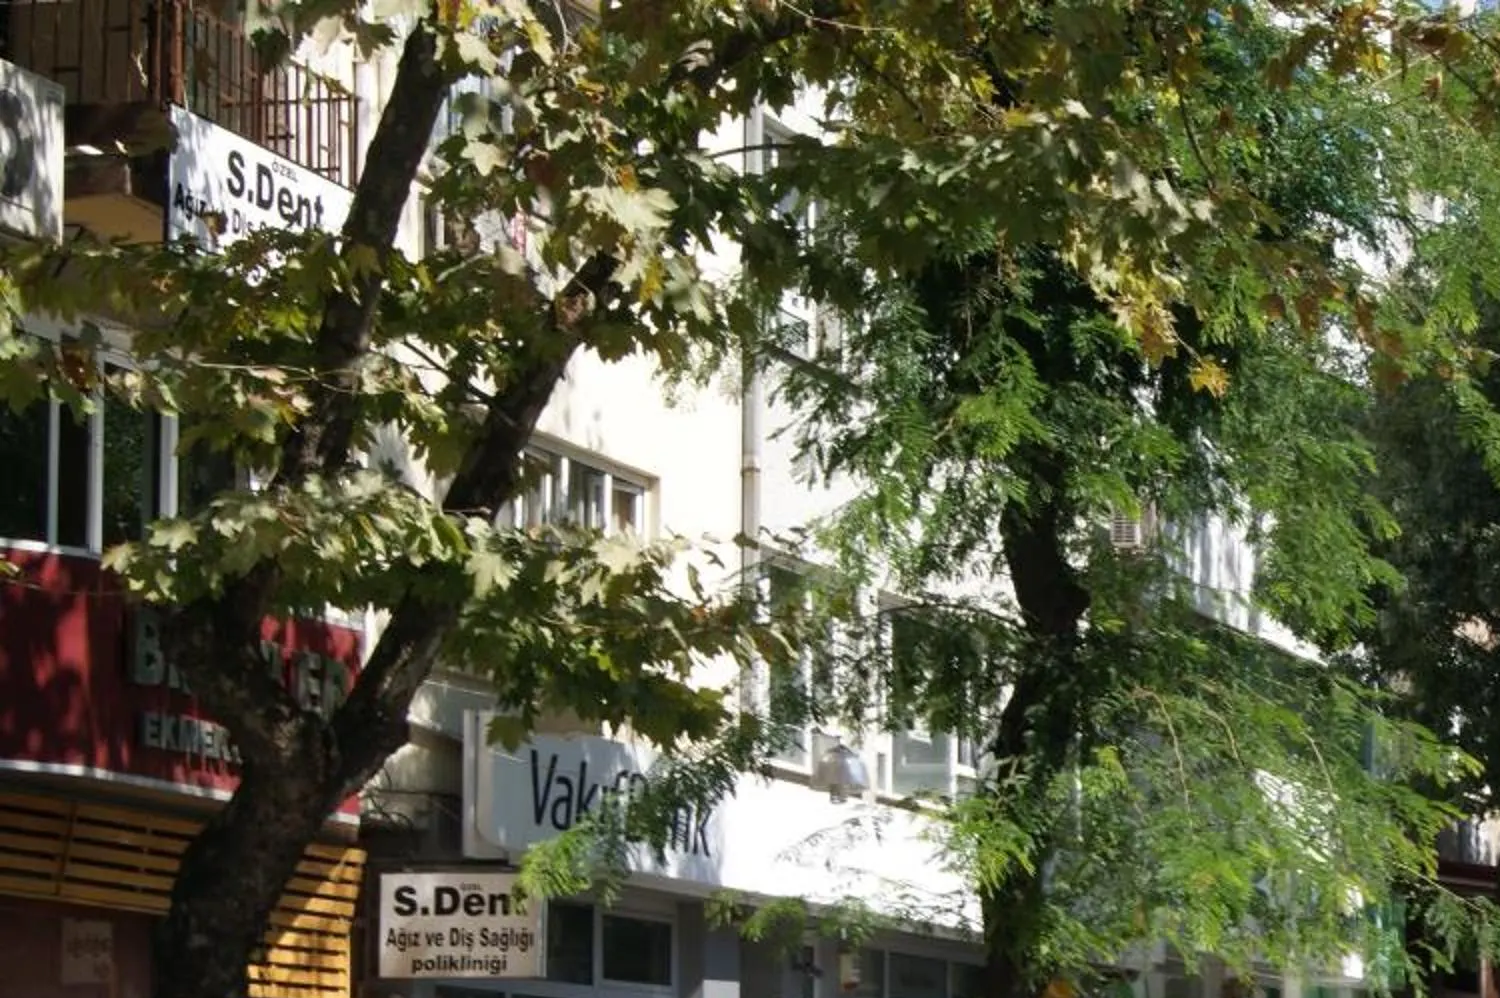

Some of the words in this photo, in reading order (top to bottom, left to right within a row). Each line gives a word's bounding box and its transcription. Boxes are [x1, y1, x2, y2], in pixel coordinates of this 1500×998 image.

[226, 150, 325, 230] S.Dent
[386, 927, 420, 952] Ağız
[425, 931, 444, 947] ve
